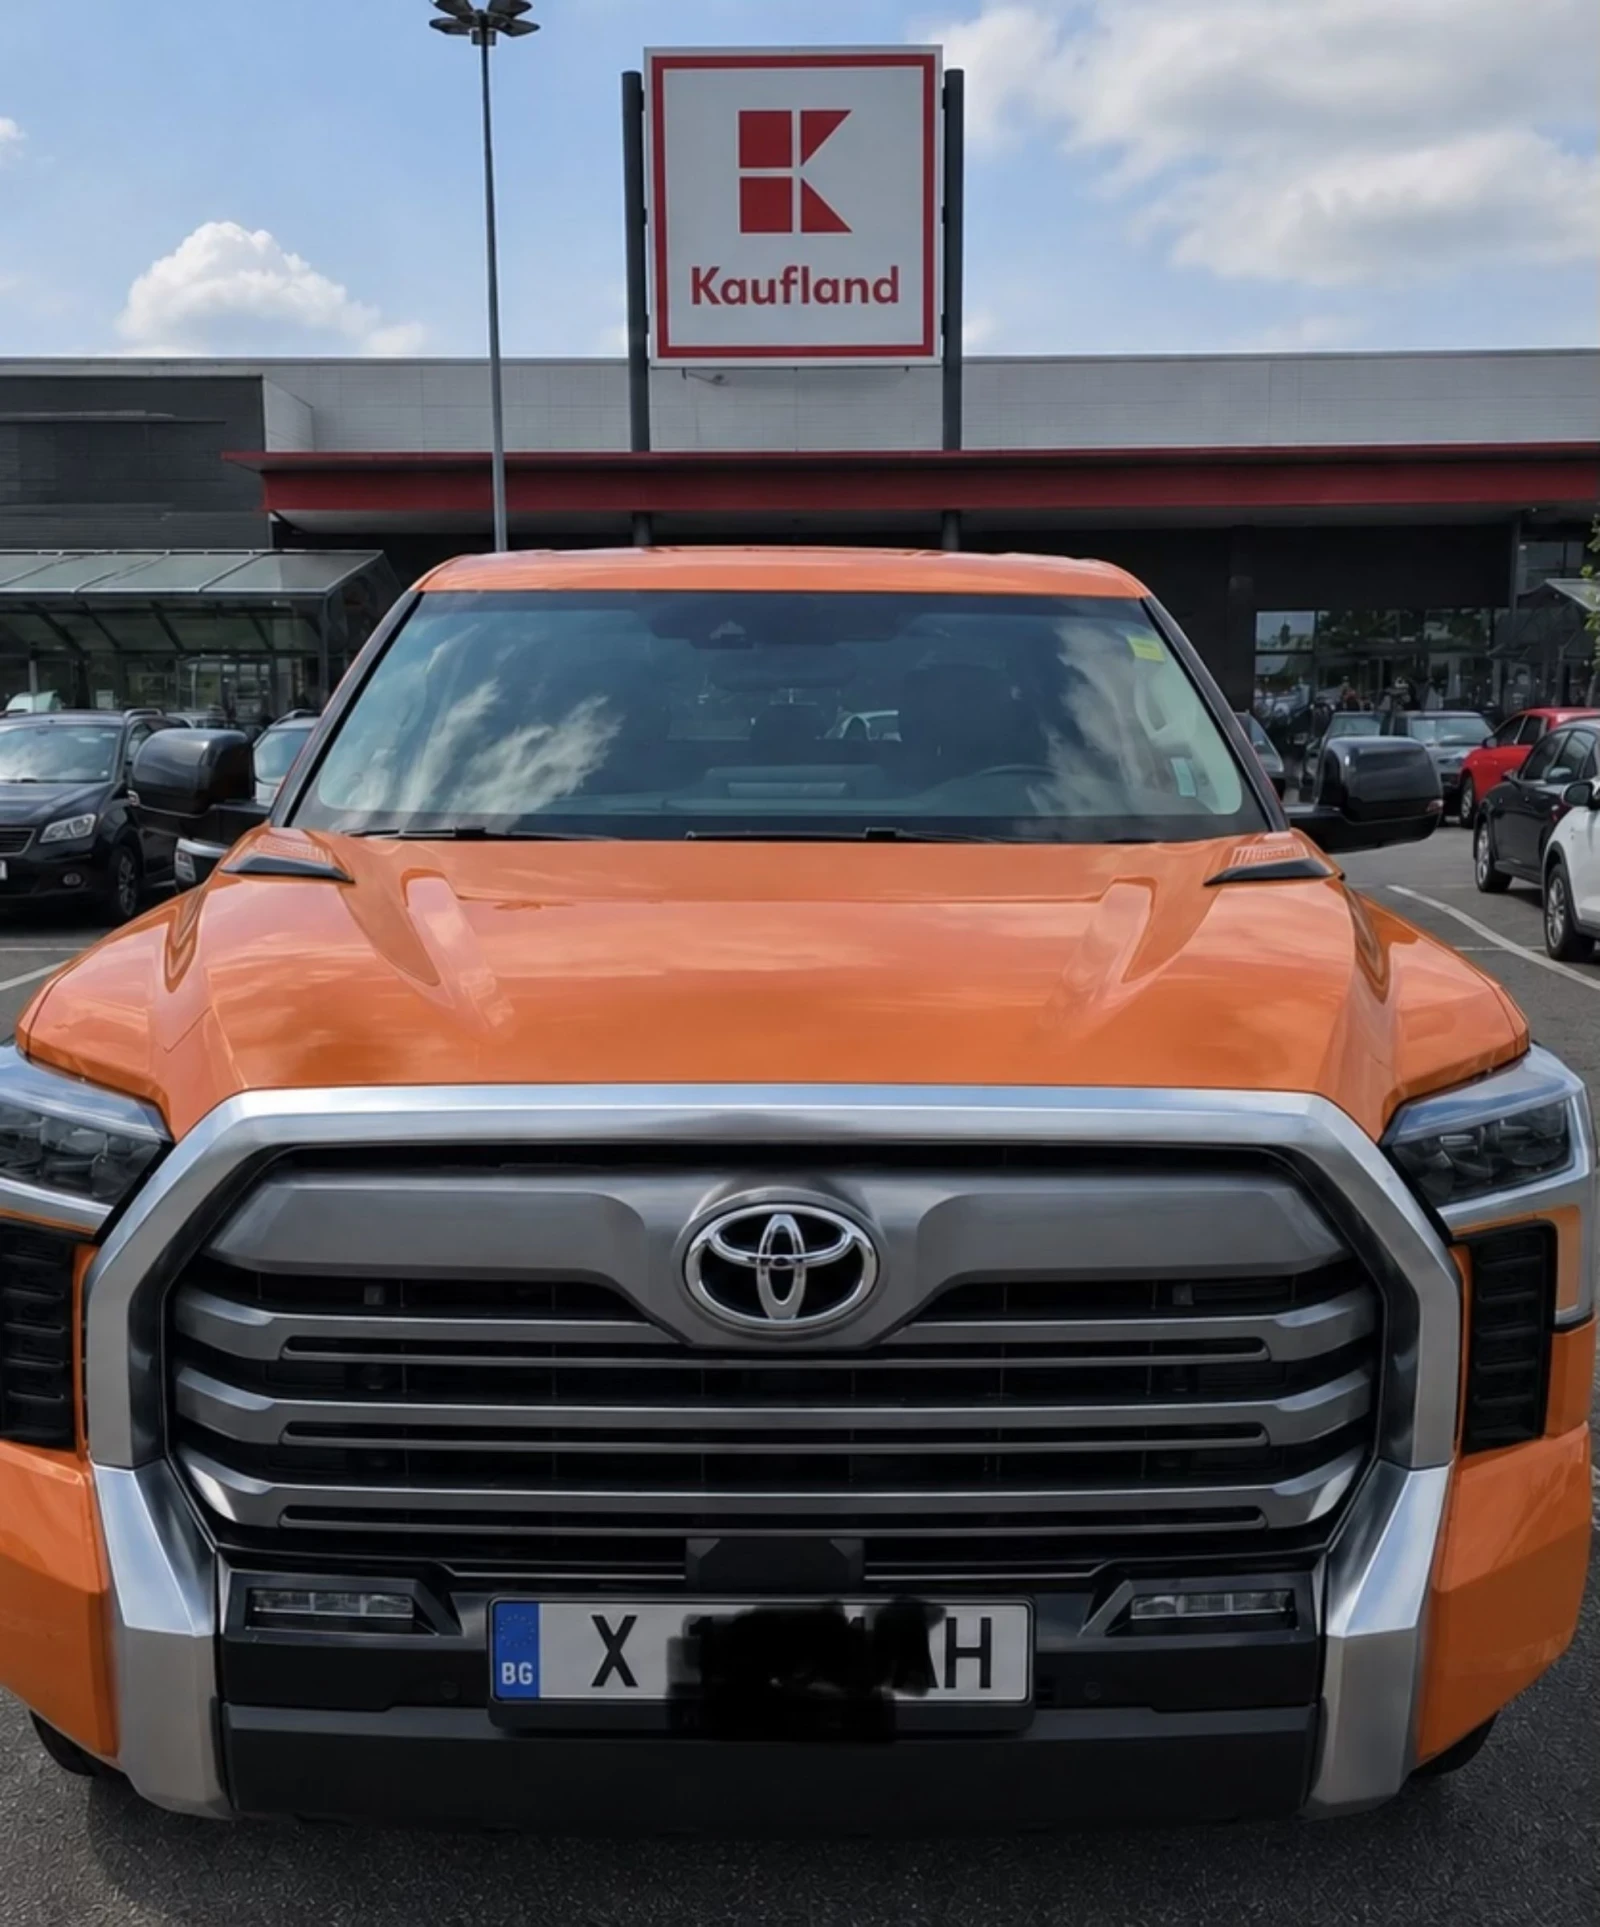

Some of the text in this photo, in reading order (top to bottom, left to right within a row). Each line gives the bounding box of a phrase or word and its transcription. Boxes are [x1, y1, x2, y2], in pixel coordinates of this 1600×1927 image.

[690, 265, 899, 305] Kaufland
[591, 1614, 638, 1687] X
[501, 1662, 533, 1685] BG
